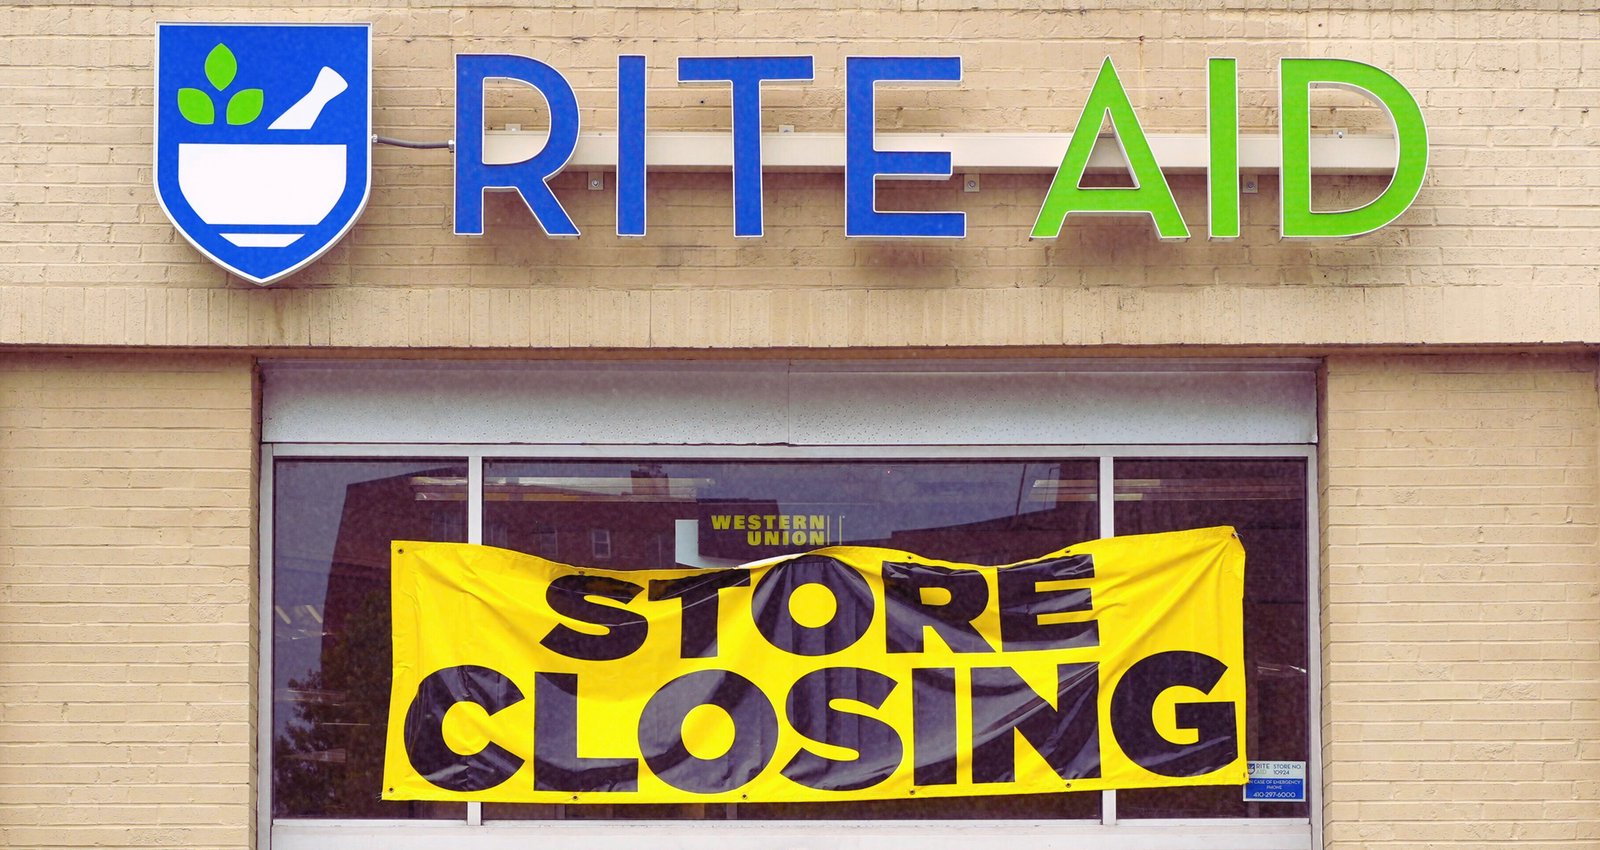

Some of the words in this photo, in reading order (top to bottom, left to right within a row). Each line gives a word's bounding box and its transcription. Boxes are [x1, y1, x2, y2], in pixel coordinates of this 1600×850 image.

[453, 53, 967, 238] RITE
[1030, 55, 1430, 240] AID
[711, 514, 825, 530] WESTERN
[747, 530, 825, 546] UNION
[539, 553, 1101, 661] STORE
[404, 649, 1238, 793] CLOSING
